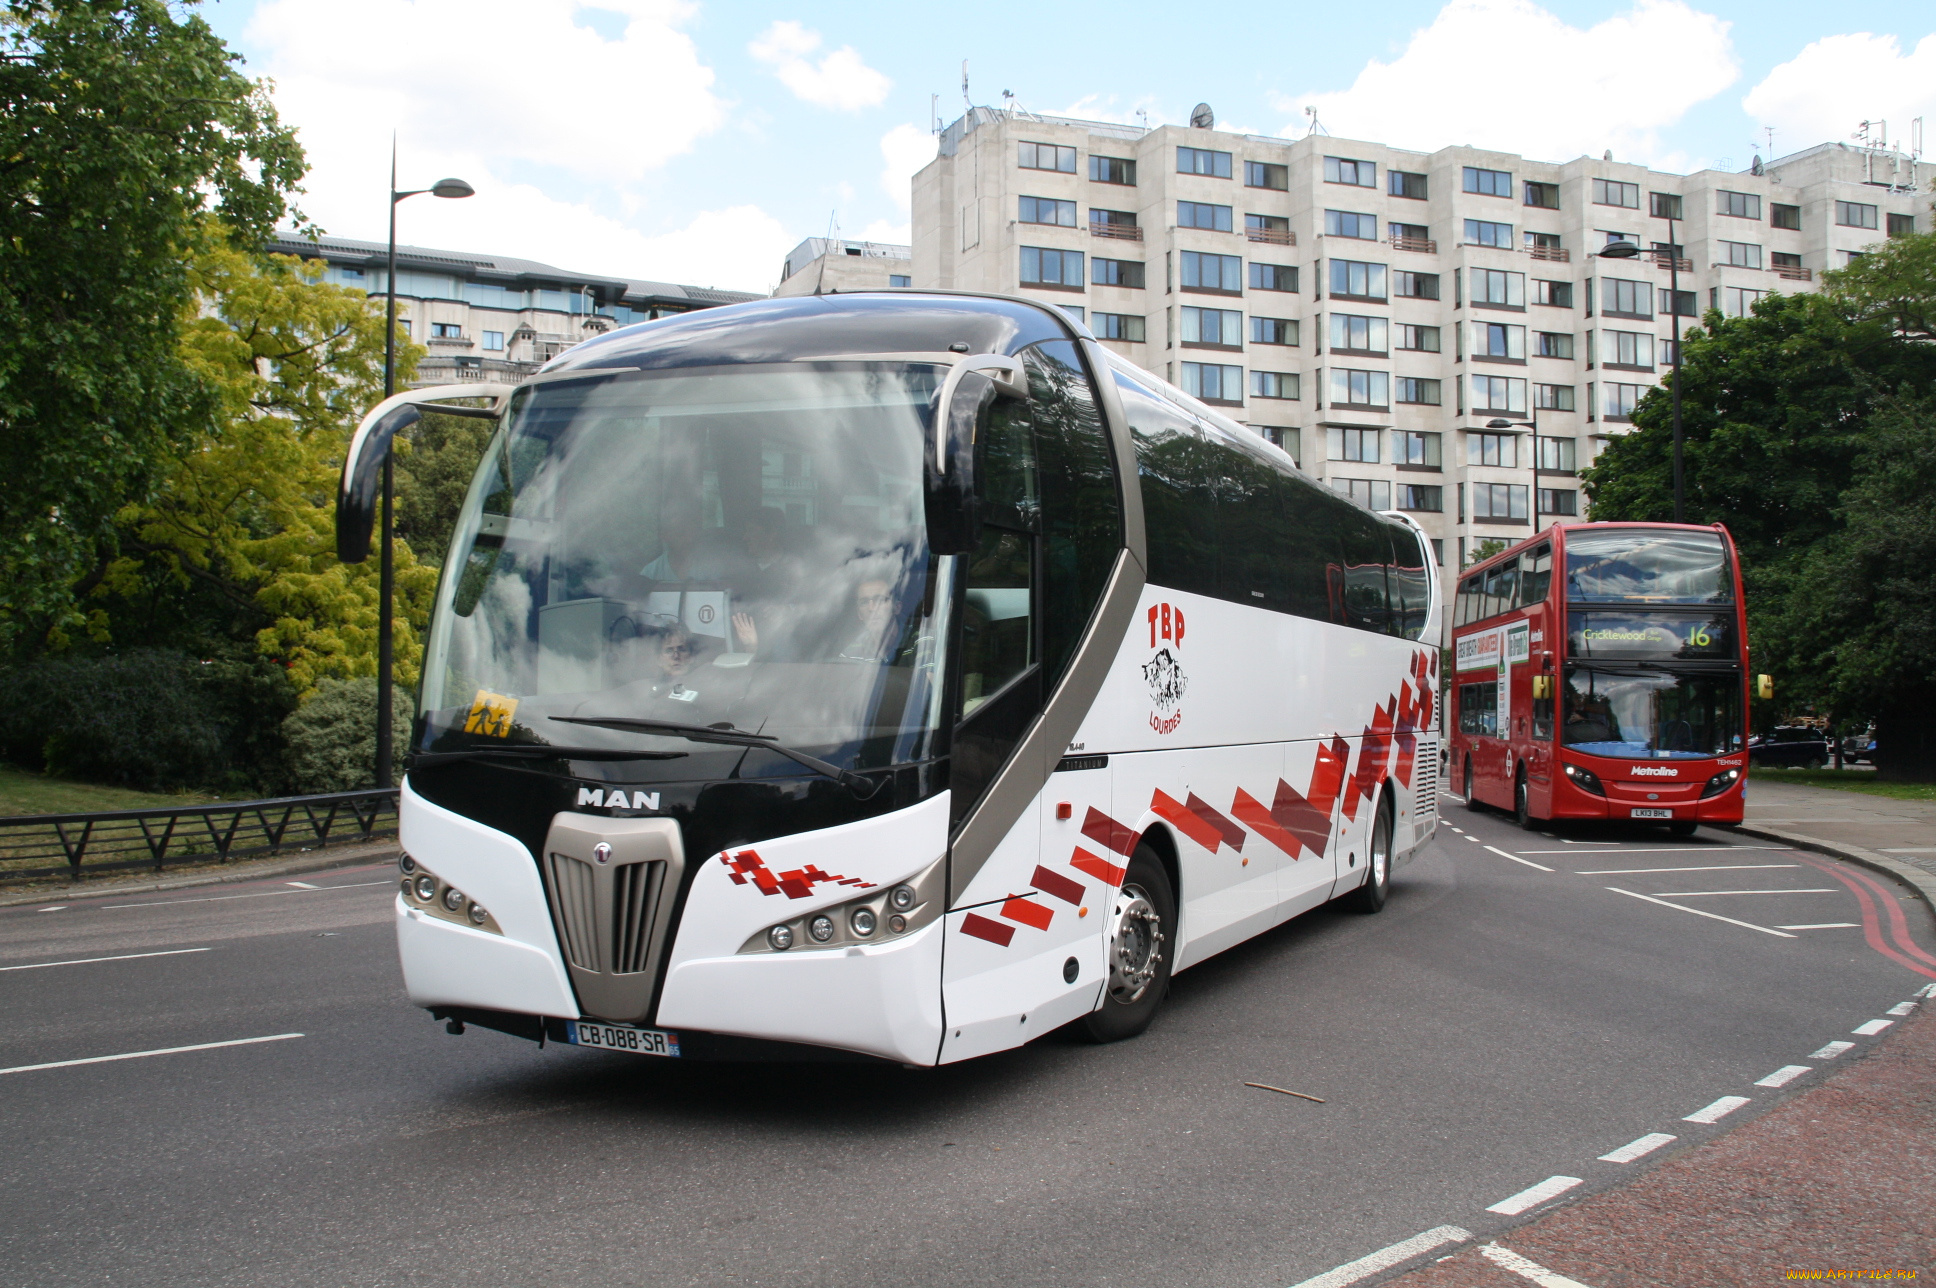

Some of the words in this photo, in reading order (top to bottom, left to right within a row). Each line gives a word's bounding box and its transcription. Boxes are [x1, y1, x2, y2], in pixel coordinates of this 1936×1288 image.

[1148, 602, 1185, 651] TBP
[1583, 628, 1646, 641] Cricklewood
[1690, 626, 1711, 647] 16
[1149, 708, 1181, 735] LOURDES
[1066, 759, 1102, 769] TITANIUM
[1630, 765, 1679, 777] Metroline
[577, 787, 660, 811] MAN
[1635, 809, 1652, 817] LK13
[1653, 810, 1668, 818] BHL
[669, 1045, 680, 1056] 65
